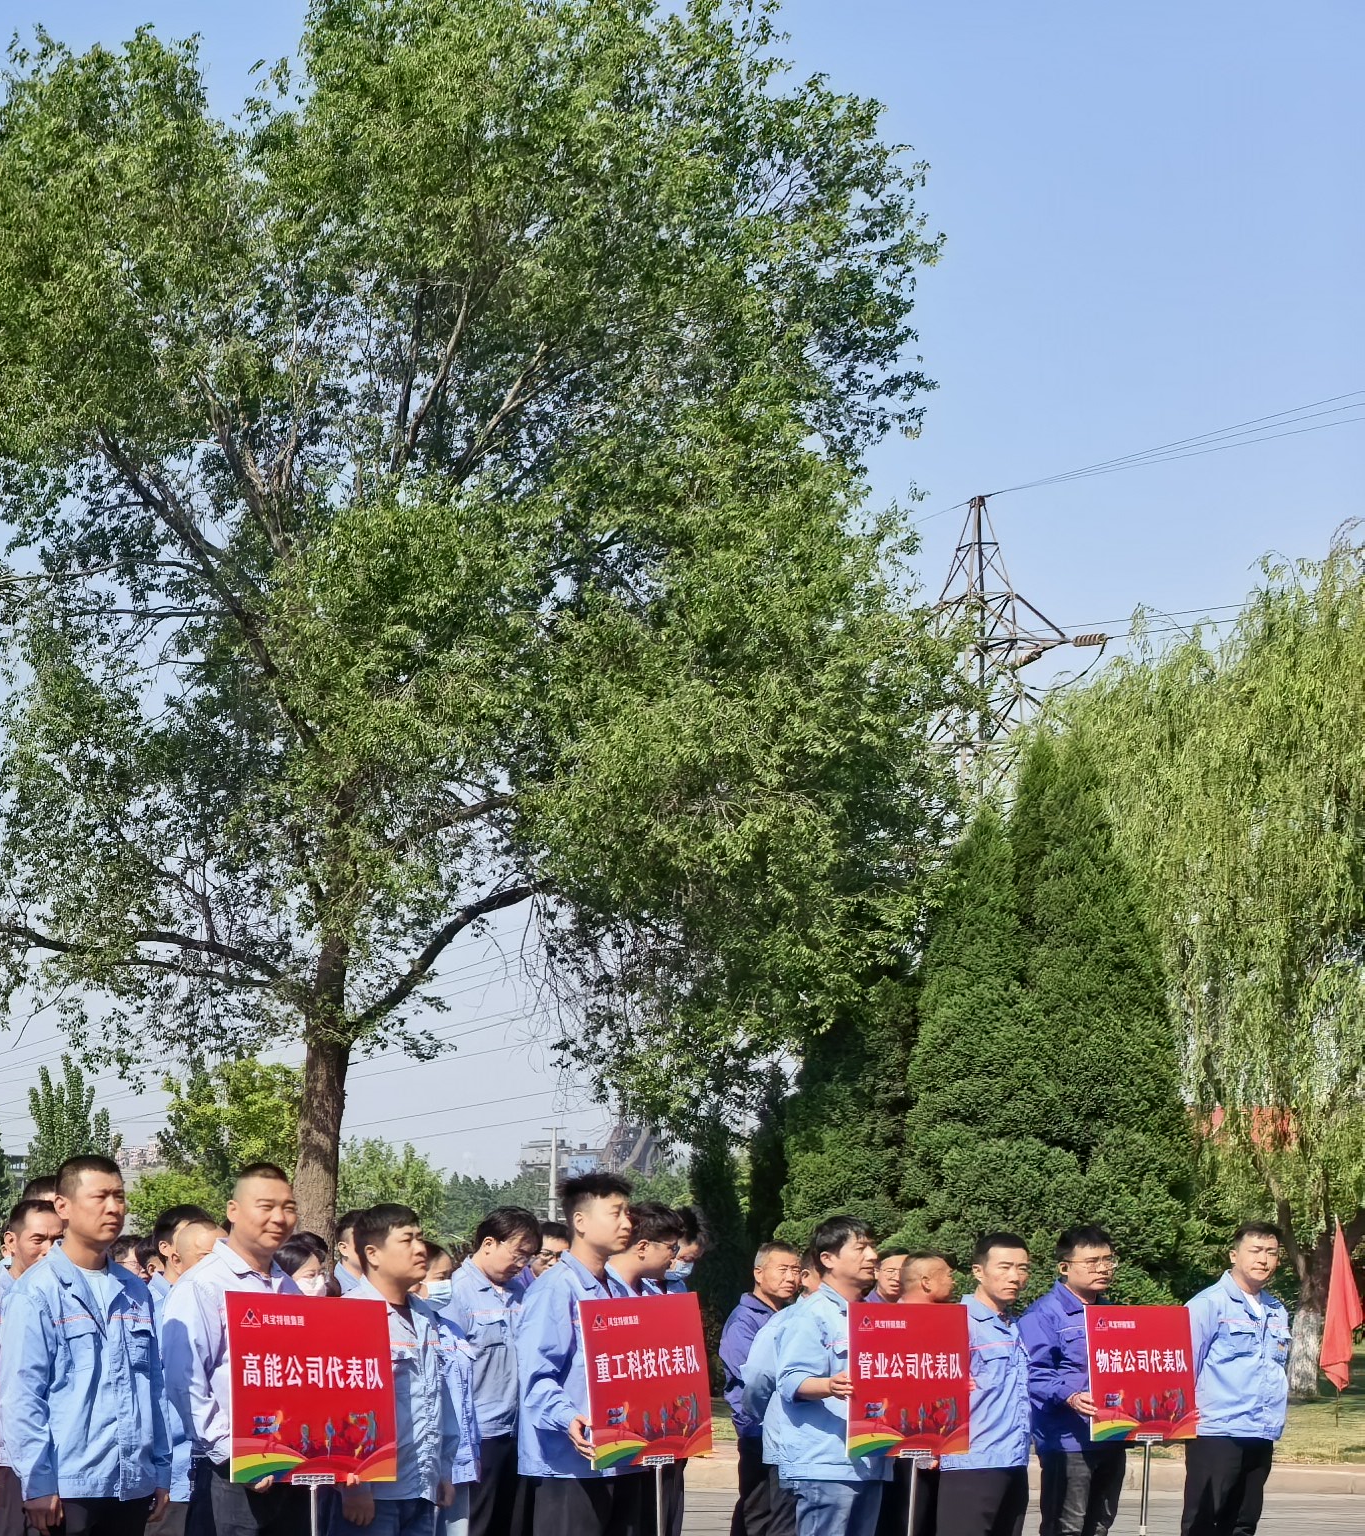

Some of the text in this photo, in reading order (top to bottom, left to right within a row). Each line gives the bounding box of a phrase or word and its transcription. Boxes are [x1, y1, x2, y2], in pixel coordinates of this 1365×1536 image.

[241, 1352, 384, 1390] 高能公司代表队
[594, 1344, 700, 1383] 重工科技代表队
[858, 1351, 963, 1380] 管业公司代表队
[1095, 1348, 1188, 1374] 物流公司代表队
